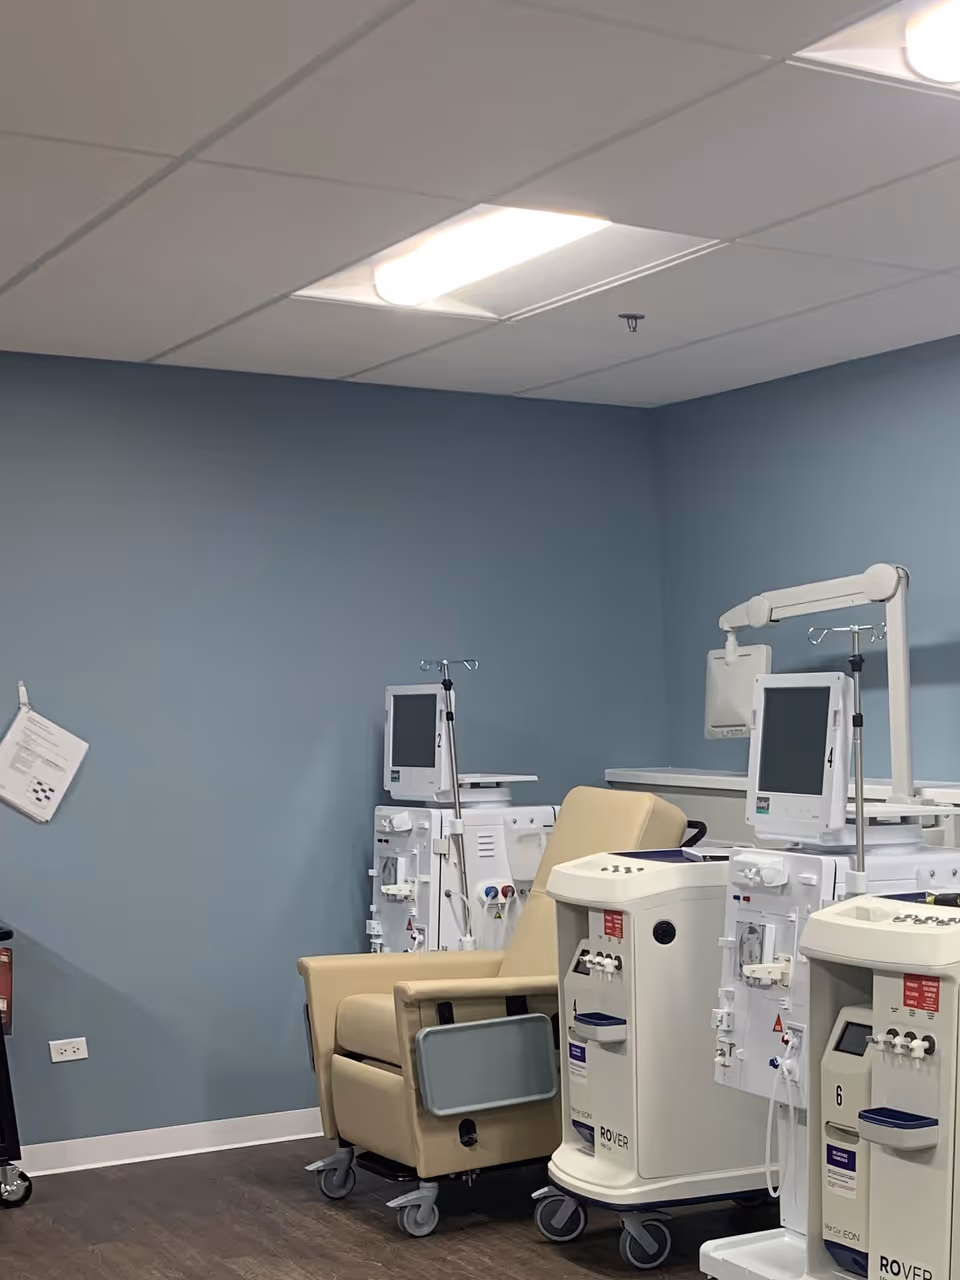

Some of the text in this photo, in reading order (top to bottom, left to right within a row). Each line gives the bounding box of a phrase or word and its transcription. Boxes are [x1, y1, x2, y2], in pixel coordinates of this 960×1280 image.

[437, 733, 442, 748] 2
[828, 747, 833, 768] 4
[836, 1084, 843, 1107] 6
[600, 1125, 629, 1150] ROVER
[843, 1229, 860, 1242] EON
